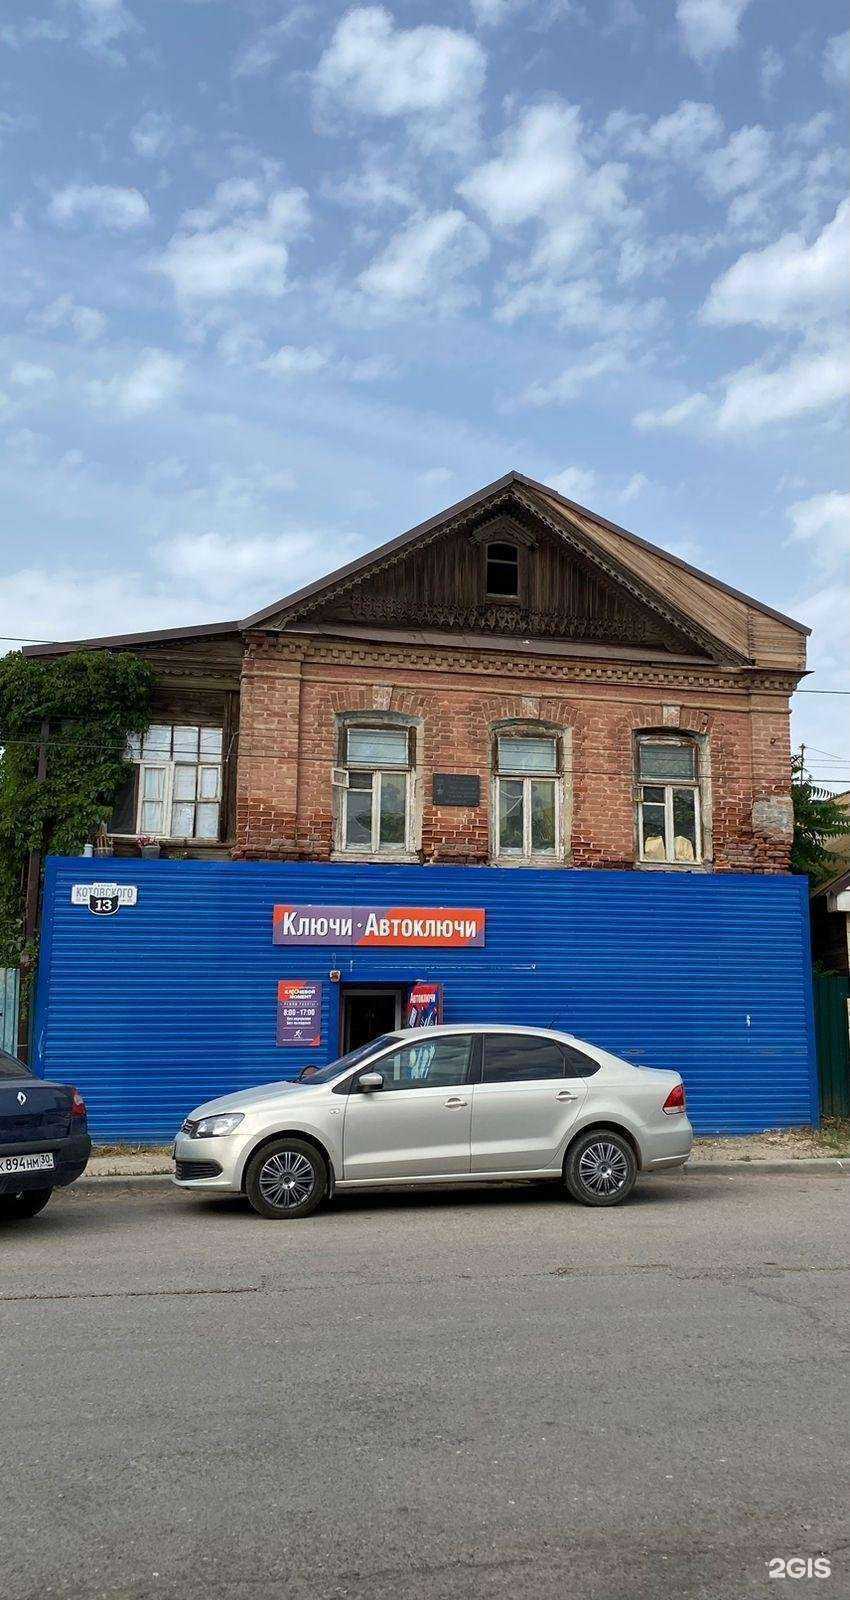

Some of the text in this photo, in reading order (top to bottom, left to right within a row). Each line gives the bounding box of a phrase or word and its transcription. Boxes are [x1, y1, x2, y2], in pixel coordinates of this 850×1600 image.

[76, 886, 133, 898] КОТОВСКОГО
[95, 899, 112, 911] 13
[282, 911, 477, 938] Ключи Автоключи
